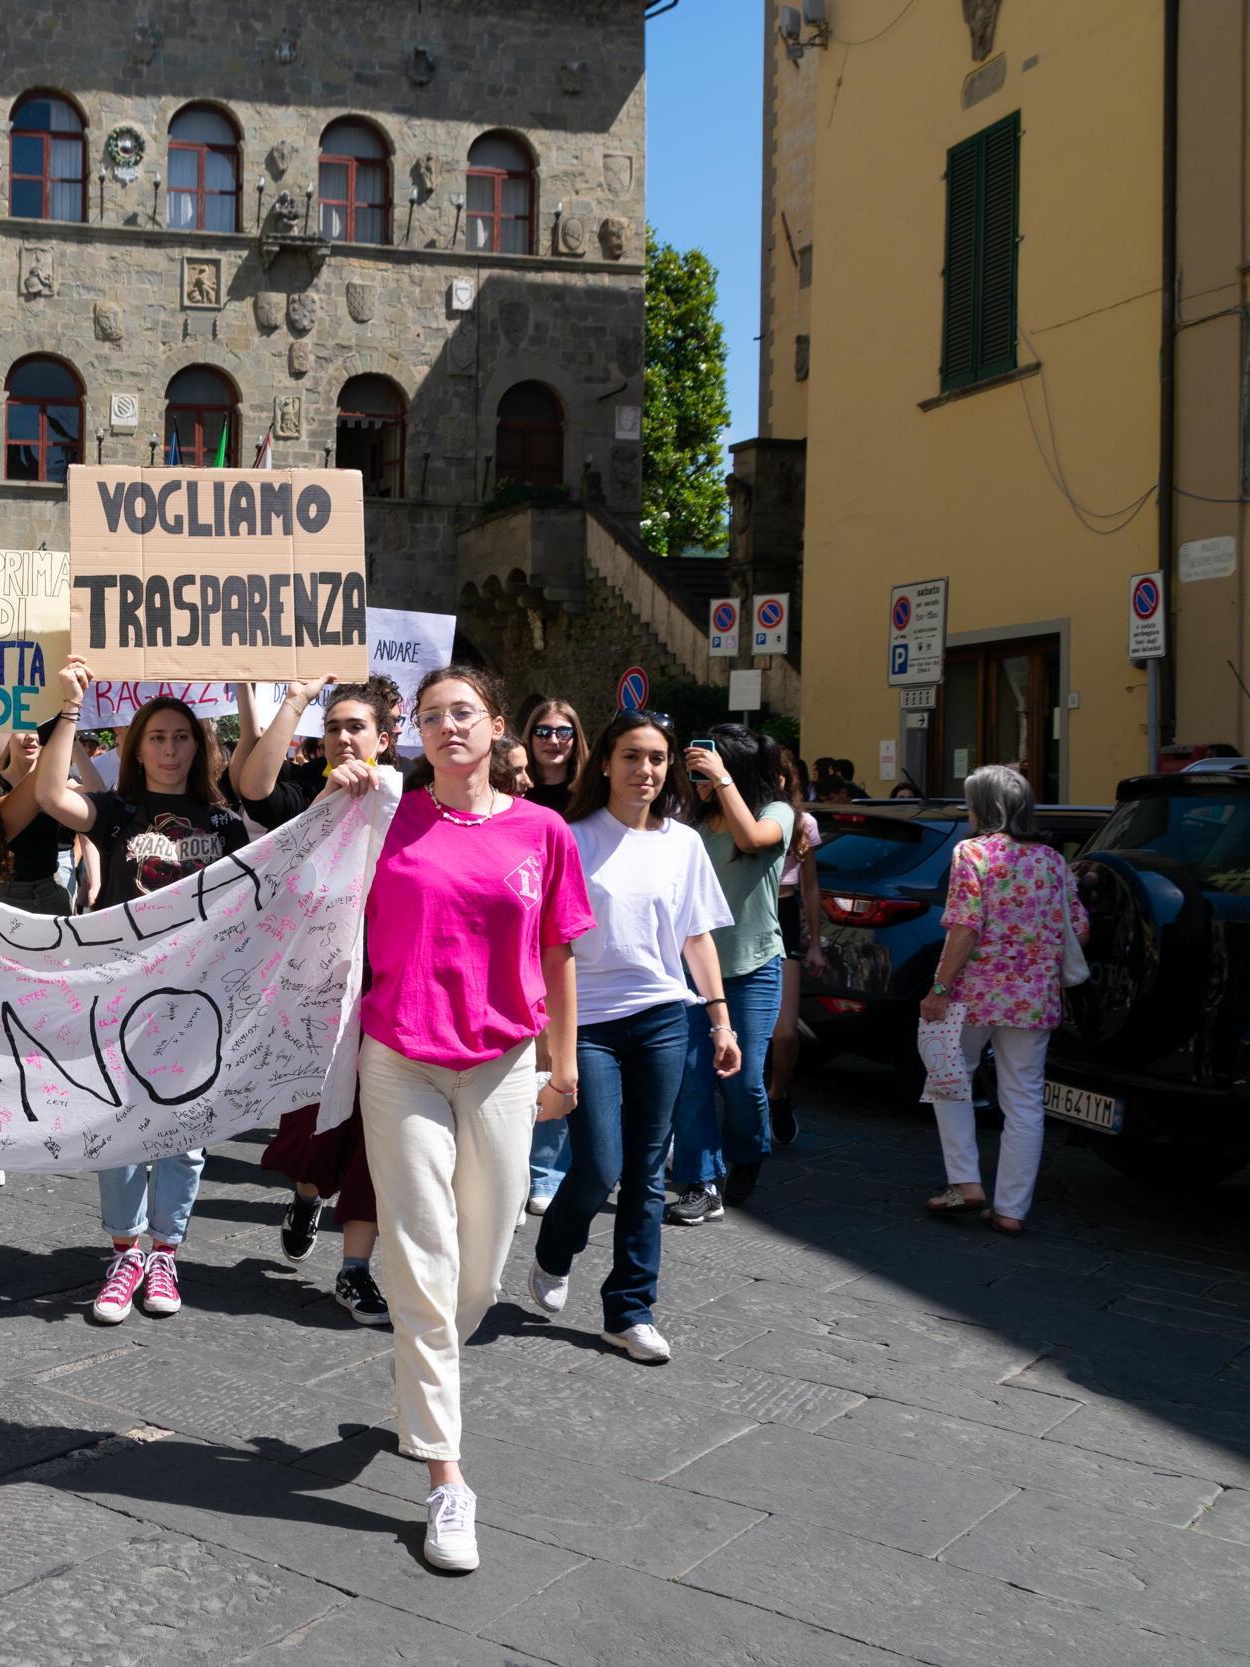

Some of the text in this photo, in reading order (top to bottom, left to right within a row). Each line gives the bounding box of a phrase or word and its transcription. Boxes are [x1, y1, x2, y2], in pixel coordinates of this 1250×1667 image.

[98, 481, 332, 537] VOGLIAMO
[73, 571, 367, 649] TRASPARENZA
[374, 639, 421, 663] ANDARE
[180, 838, 219, 859] ROCK
[1, 986, 223, 1122] NO
